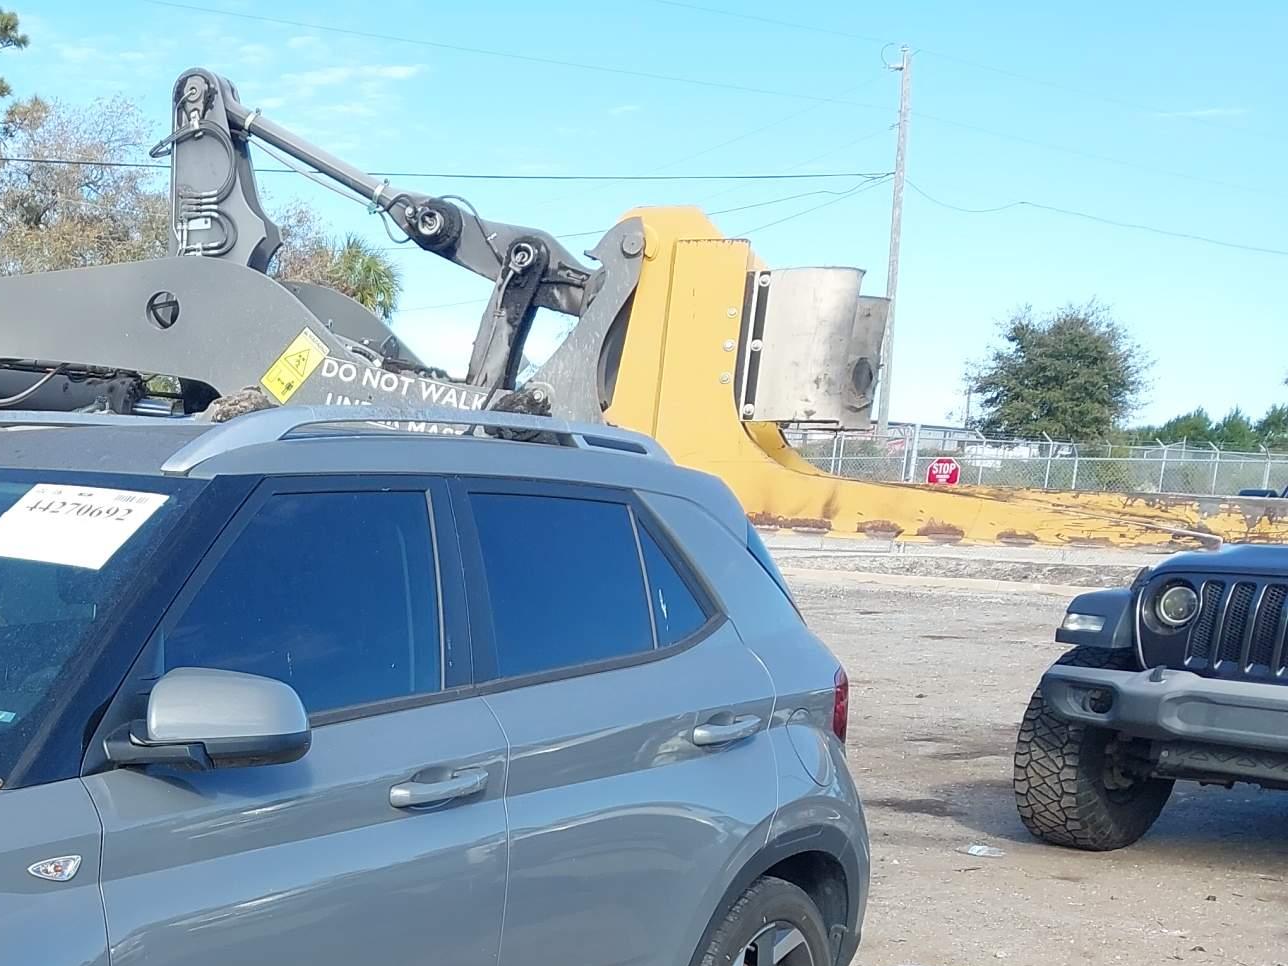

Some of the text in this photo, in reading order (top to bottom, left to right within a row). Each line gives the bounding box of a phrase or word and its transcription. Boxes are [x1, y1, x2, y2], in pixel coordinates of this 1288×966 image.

[321, 359, 488, 411] DO NOT WALK
[932, 462, 956, 474] STOP
[25, 499, 133, 521] 44270692
